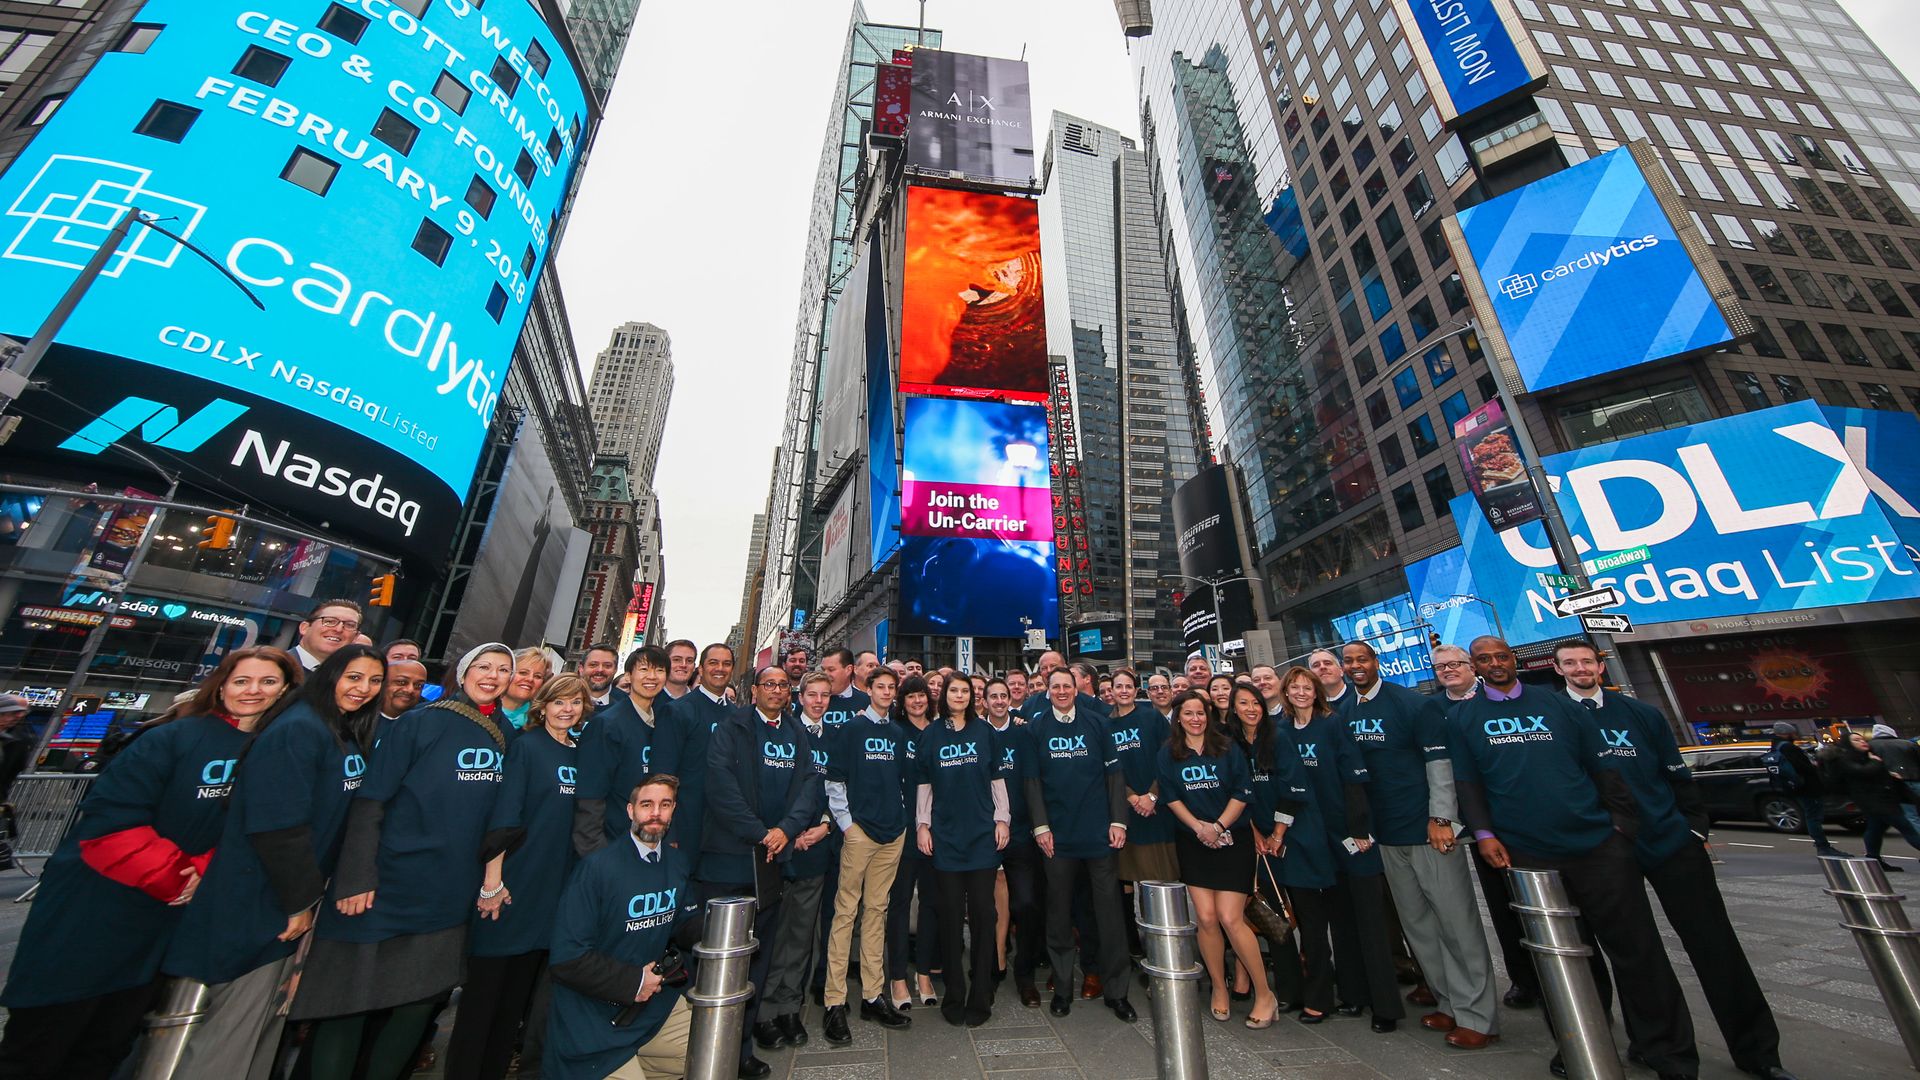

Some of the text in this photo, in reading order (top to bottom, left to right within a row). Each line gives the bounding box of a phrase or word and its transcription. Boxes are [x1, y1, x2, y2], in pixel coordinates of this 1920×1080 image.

[1449, 33, 1496, 86] NOW
[347, 0, 555, 178] COTT GRIMES
[480, 15, 575, 161] WELCOME
[919, 110, 1023, 129] ARMANI EXCHANGE
[235, 10, 547, 253] CEO & CO-FOUNDER
[194, 76, 452, 214] FEBRUARY
[483, 243, 526, 305] 2018
[1540, 233, 1660, 283] cardlytics
[158, 324, 264, 371] CDLX
[230, 428, 422, 537] Nasdaq
[927, 490, 1000, 511] Join the
[928, 511, 1028, 533] Un-Carrier
[1595, 547, 1647, 571] Broadway
[1546, 575, 1556, 586] W
[1558, 576, 1569, 587] 43
[1525, 560, 1759, 624] Nsdaq
[98, 597, 159, 616] Nsdaq
[635, 584, 653, 632] Foot Locker
[1563, 594, 1607, 612] ONE WAY
[1590, 619, 1625, 628] ONE WAY
[1712, 614, 1817, 631] THOMSON REUTERS
[123, 655, 181, 673] Nasdaq
[1483, 715, 1550, 736] CDLX
[1048, 734, 1087, 751] CDLX
[1489, 732, 1553, 746] Nasdaq Listed
[939, 741, 978, 760] CDLX
[457, 771, 494, 782] Nasdaq
[628, 887, 678, 919] CDLX
